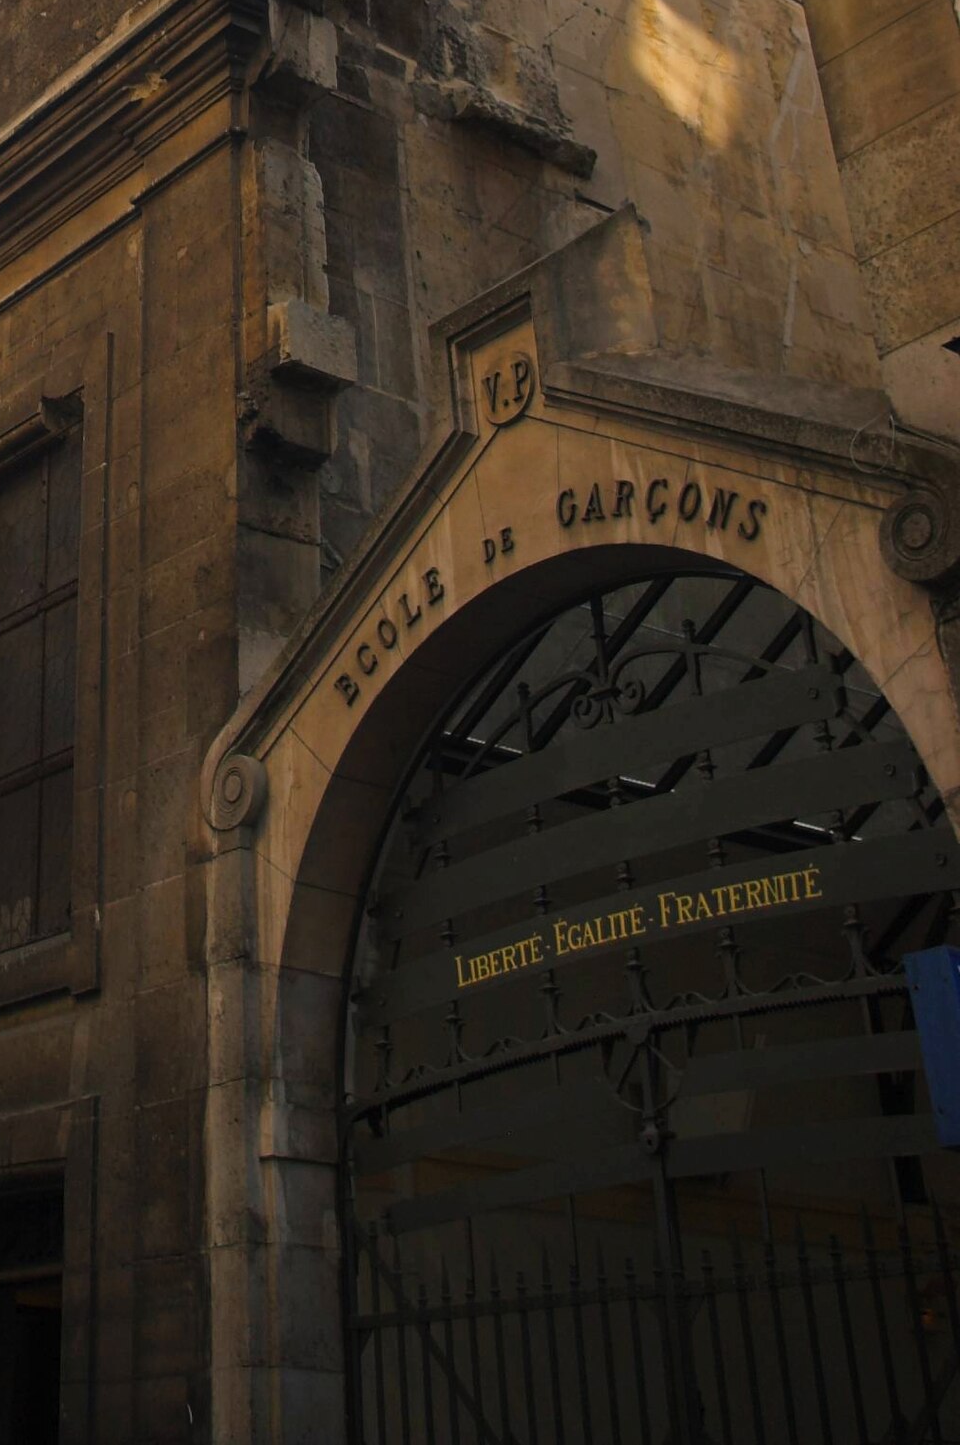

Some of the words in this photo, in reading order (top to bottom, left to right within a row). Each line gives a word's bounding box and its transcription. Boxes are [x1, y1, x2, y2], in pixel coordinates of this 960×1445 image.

[333, 566, 446, 707] ECOLE
[483, 526, 515, 564] DE
[556, 478, 768, 542] GARÇONS
[455, 932, 544, 988] LIBERTÉ
[553, 903, 647, 957] ÉGALITÉ
[658, 864, 824, 928] FRATERNITÉ
